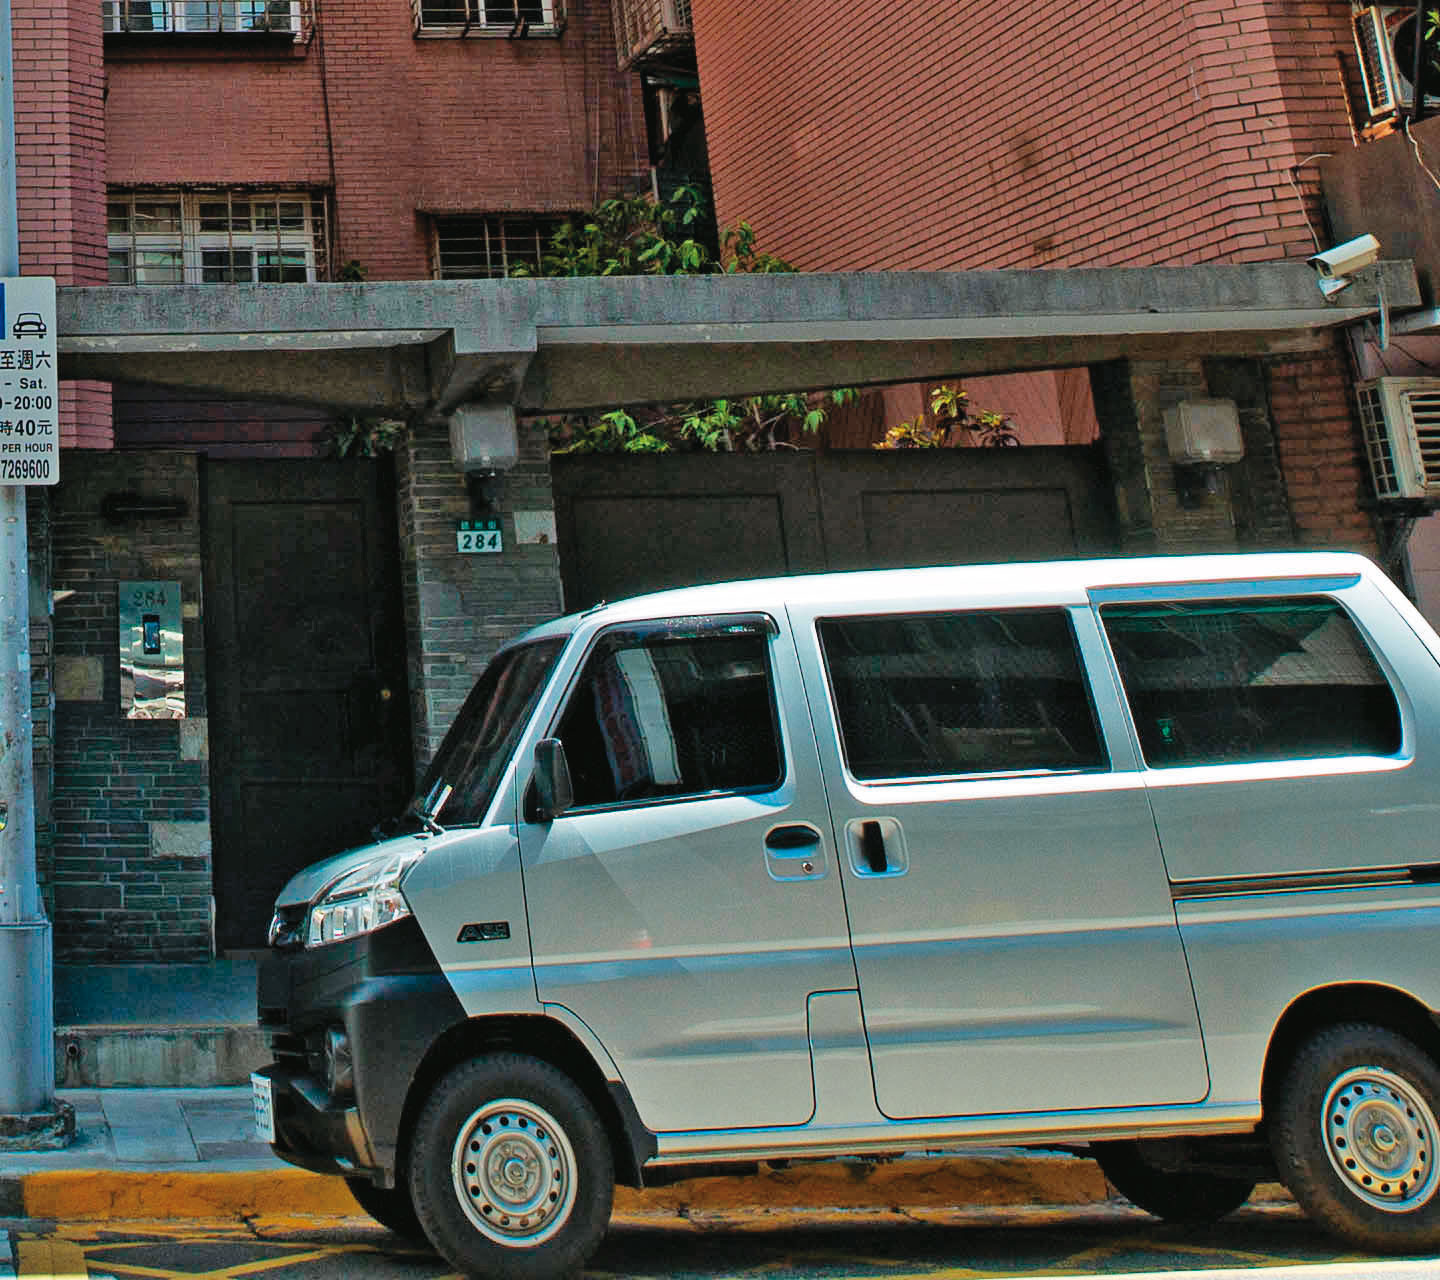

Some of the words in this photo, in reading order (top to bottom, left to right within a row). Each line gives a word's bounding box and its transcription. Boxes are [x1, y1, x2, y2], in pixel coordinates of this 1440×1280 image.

[19, 378, 47, 391] Sat.
[2, 444, 21, 454] PER
[24, 443, 53, 453] HOUR
[462, 533, 498, 550] 284
